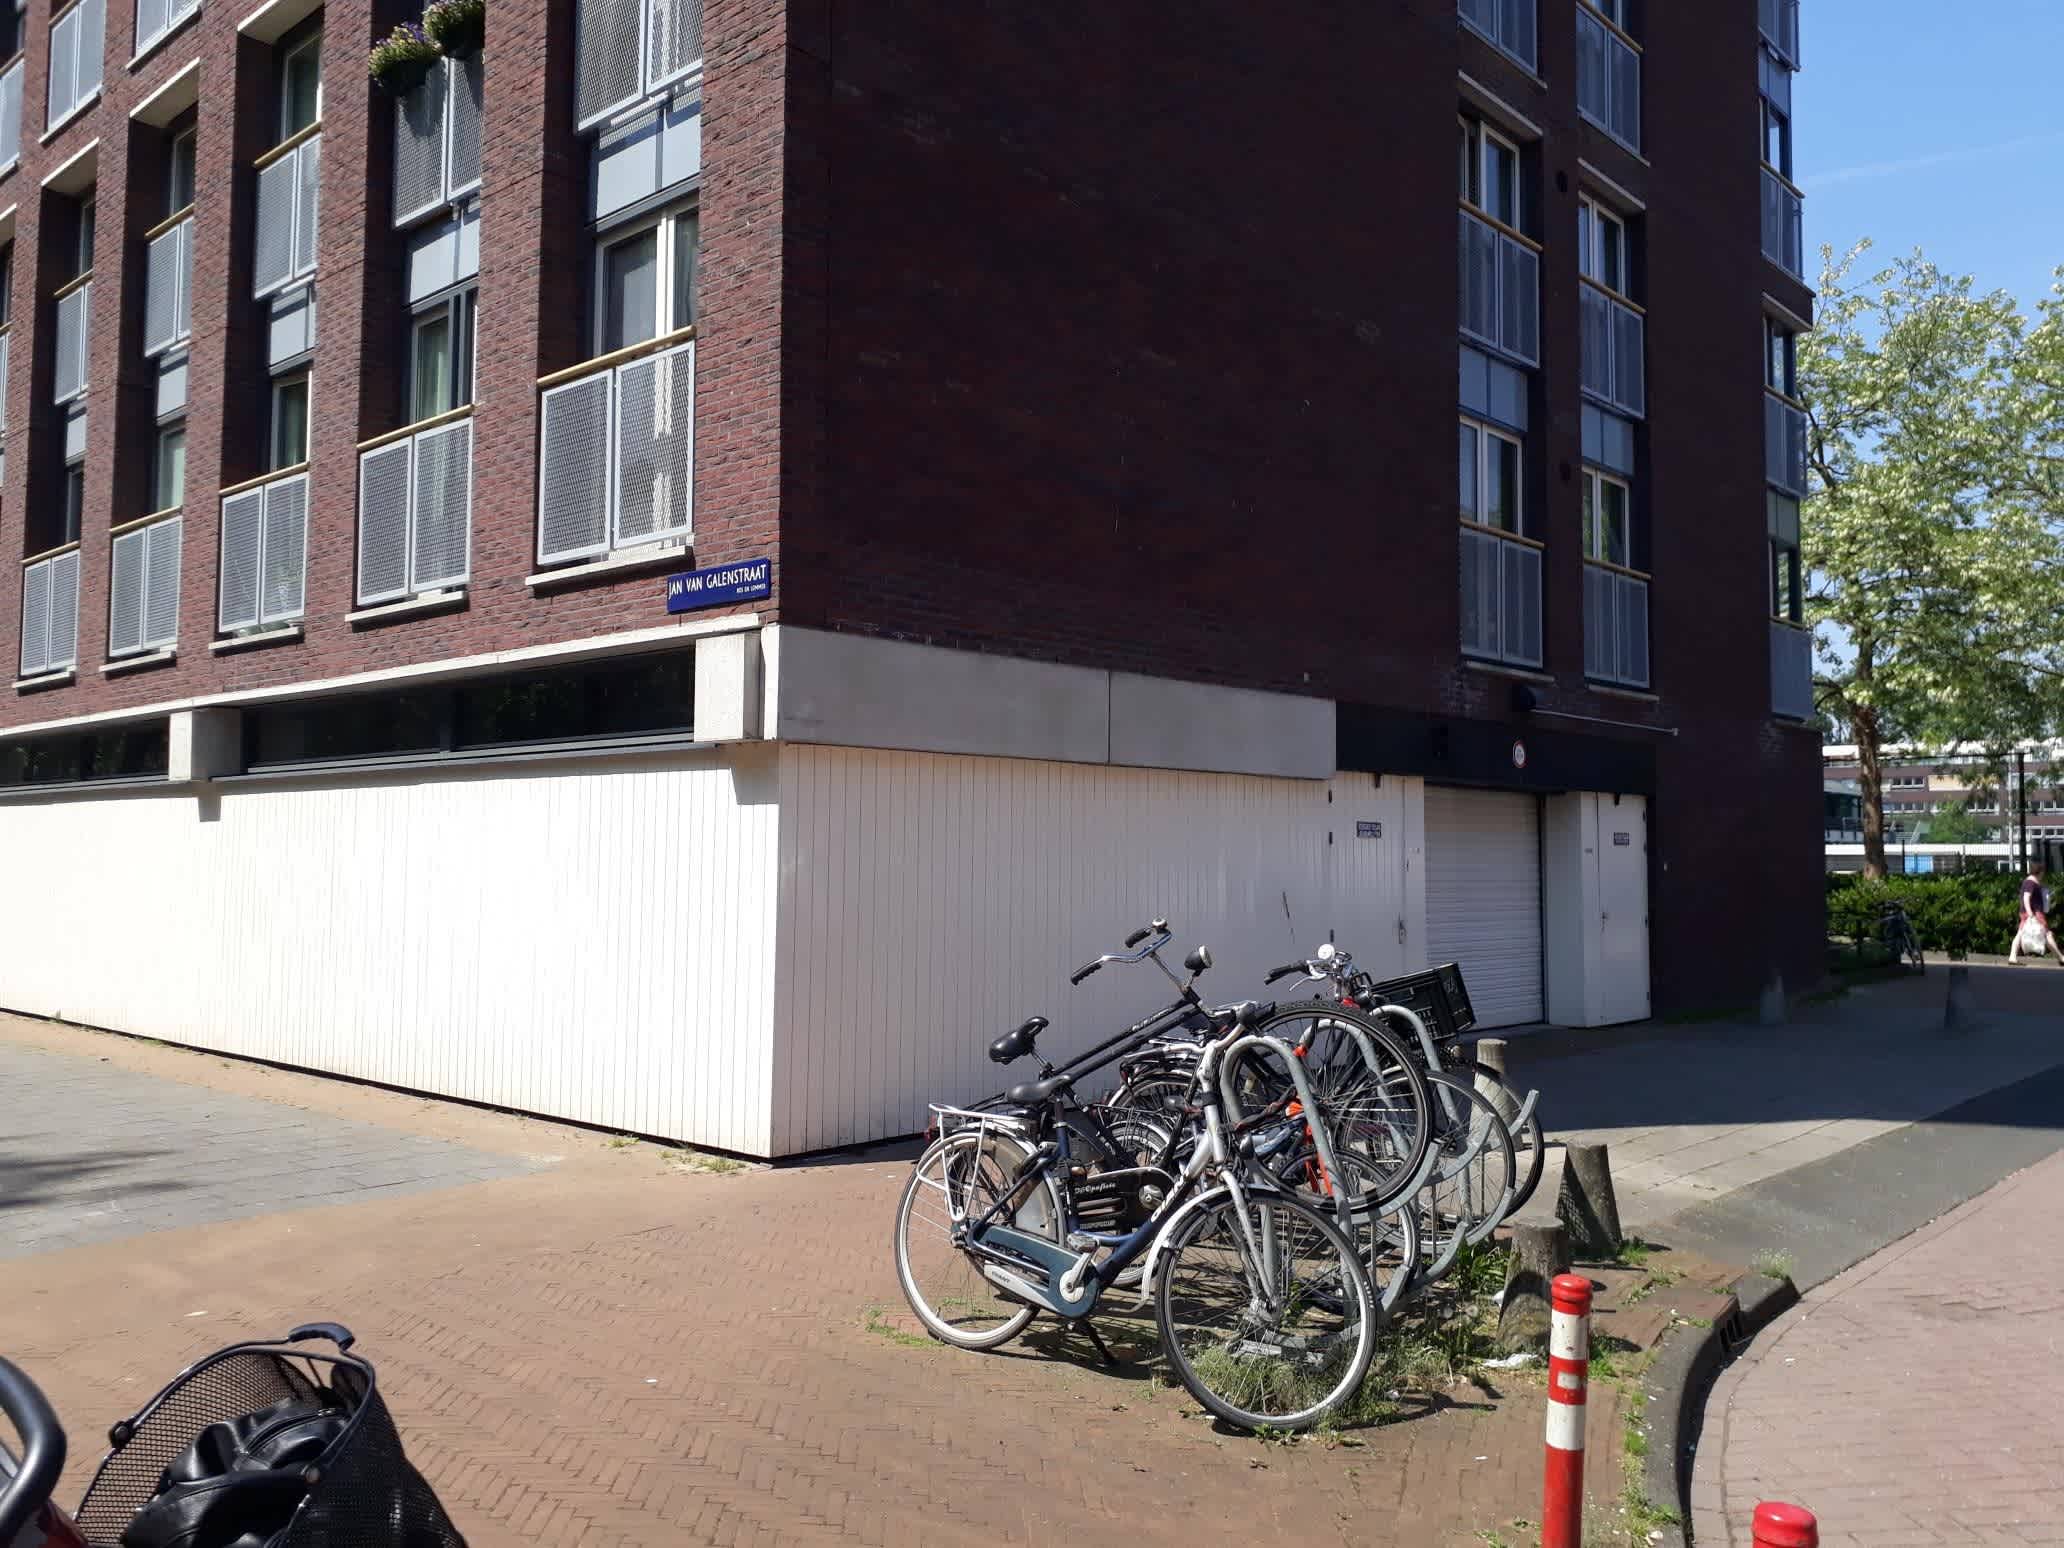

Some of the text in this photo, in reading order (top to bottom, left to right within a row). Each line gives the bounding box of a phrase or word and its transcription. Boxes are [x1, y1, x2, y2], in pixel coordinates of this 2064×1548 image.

[668, 564, 767, 600] JAN VAN GALENSTRAAT
